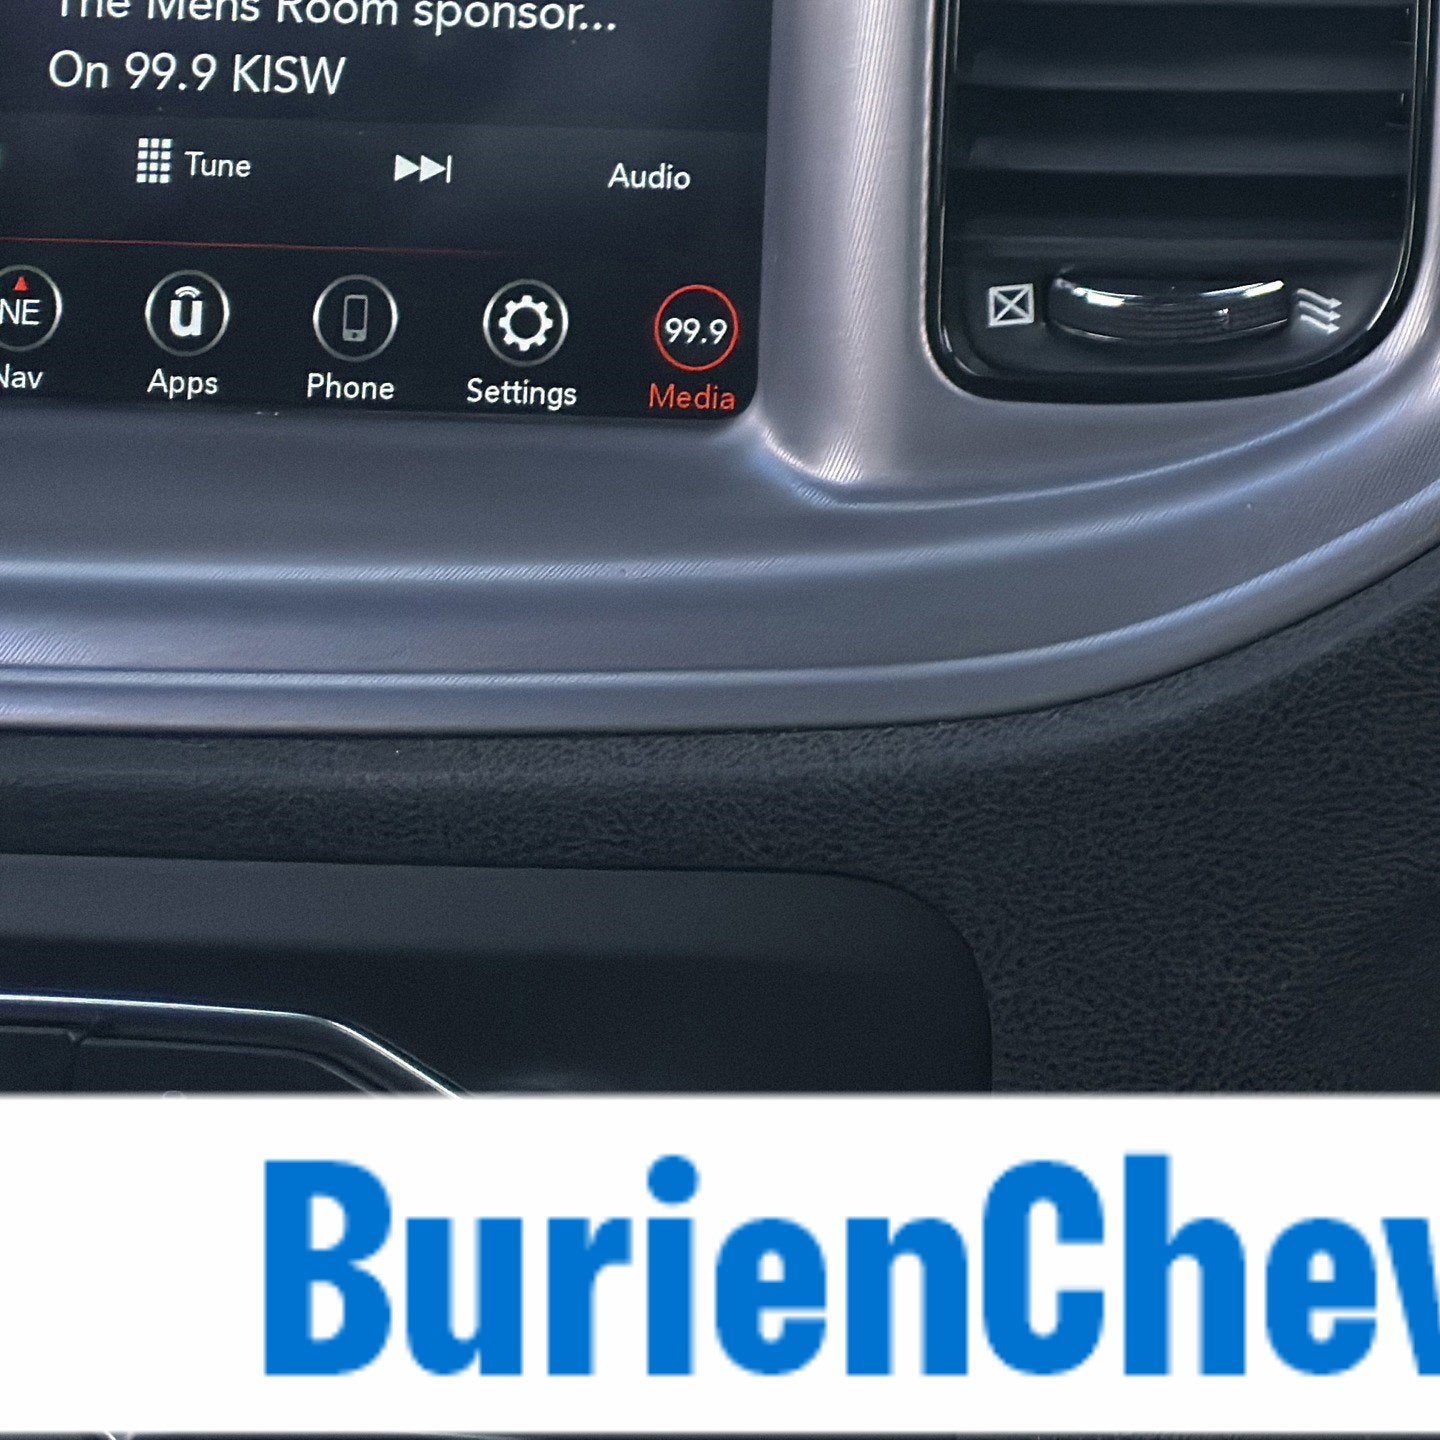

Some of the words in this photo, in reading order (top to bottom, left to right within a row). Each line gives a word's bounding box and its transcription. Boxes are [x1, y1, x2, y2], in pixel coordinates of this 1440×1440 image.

[413, 0, 616, 36] sponsor...
[48, 49, 109, 89] On
[124, 51, 218, 92] 99.9
[233, 54, 346, 96] KISW
[184, 150, 252, 178] Tune
[607, 162, 691, 191] Audio
[0, 299, 41, 326] NE
[664, 317, 728, 345] 99.9
[146, 368, 219, 401] Apps
[306, 372, 395, 401] Phone
[466, 377, 578, 411] Settings
[648, 382, 736, 411] Media
